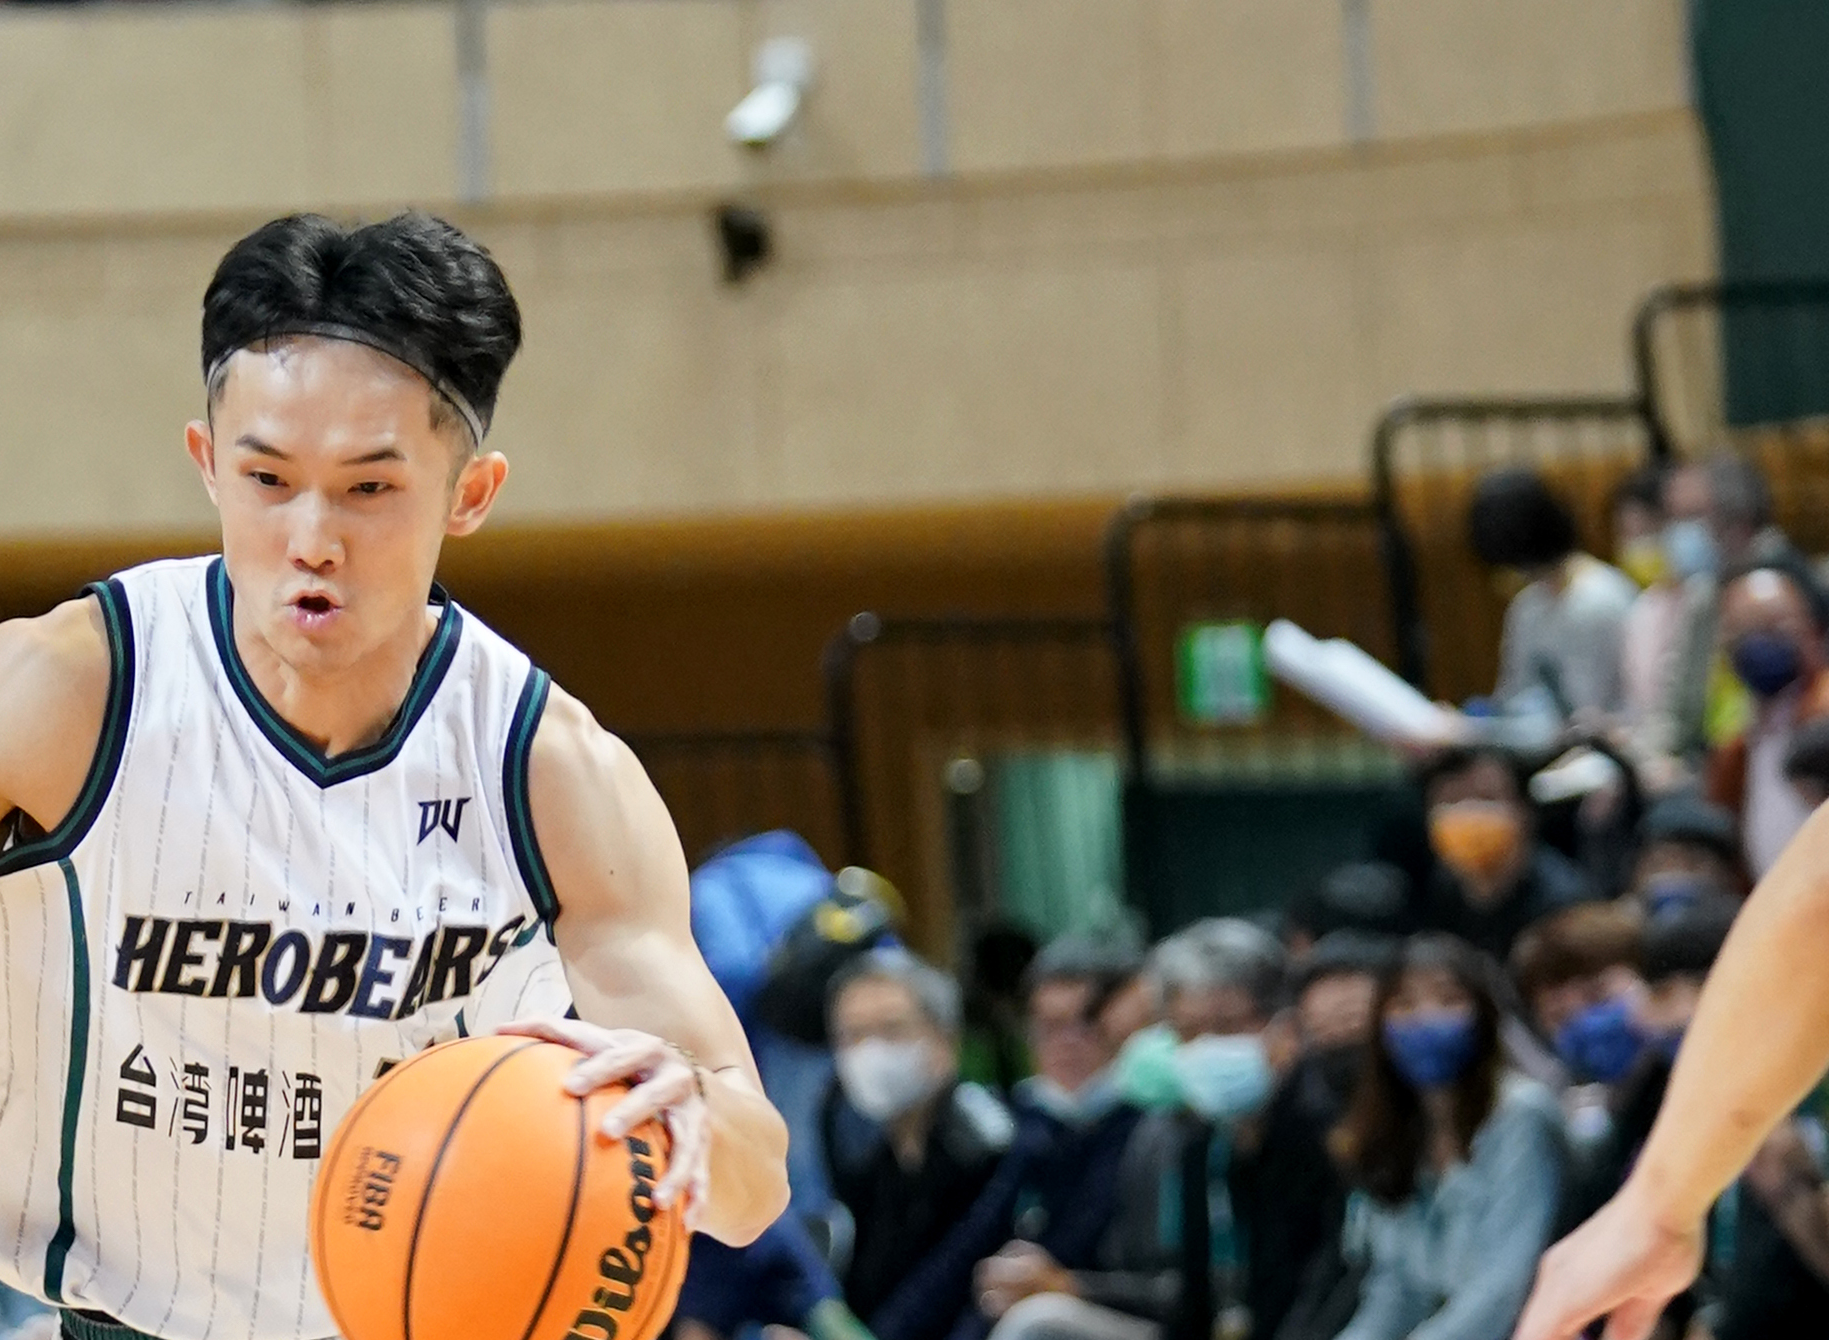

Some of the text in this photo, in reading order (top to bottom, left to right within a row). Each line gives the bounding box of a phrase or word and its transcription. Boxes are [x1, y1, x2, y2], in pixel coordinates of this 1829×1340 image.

[183, 891, 482, 923] TAIWAN BEER
[112, 914, 526, 1021] HEROBEARS
[116, 1043, 322, 1160] 台灣啤酒
[358, 1151, 402, 1231] FIBA
